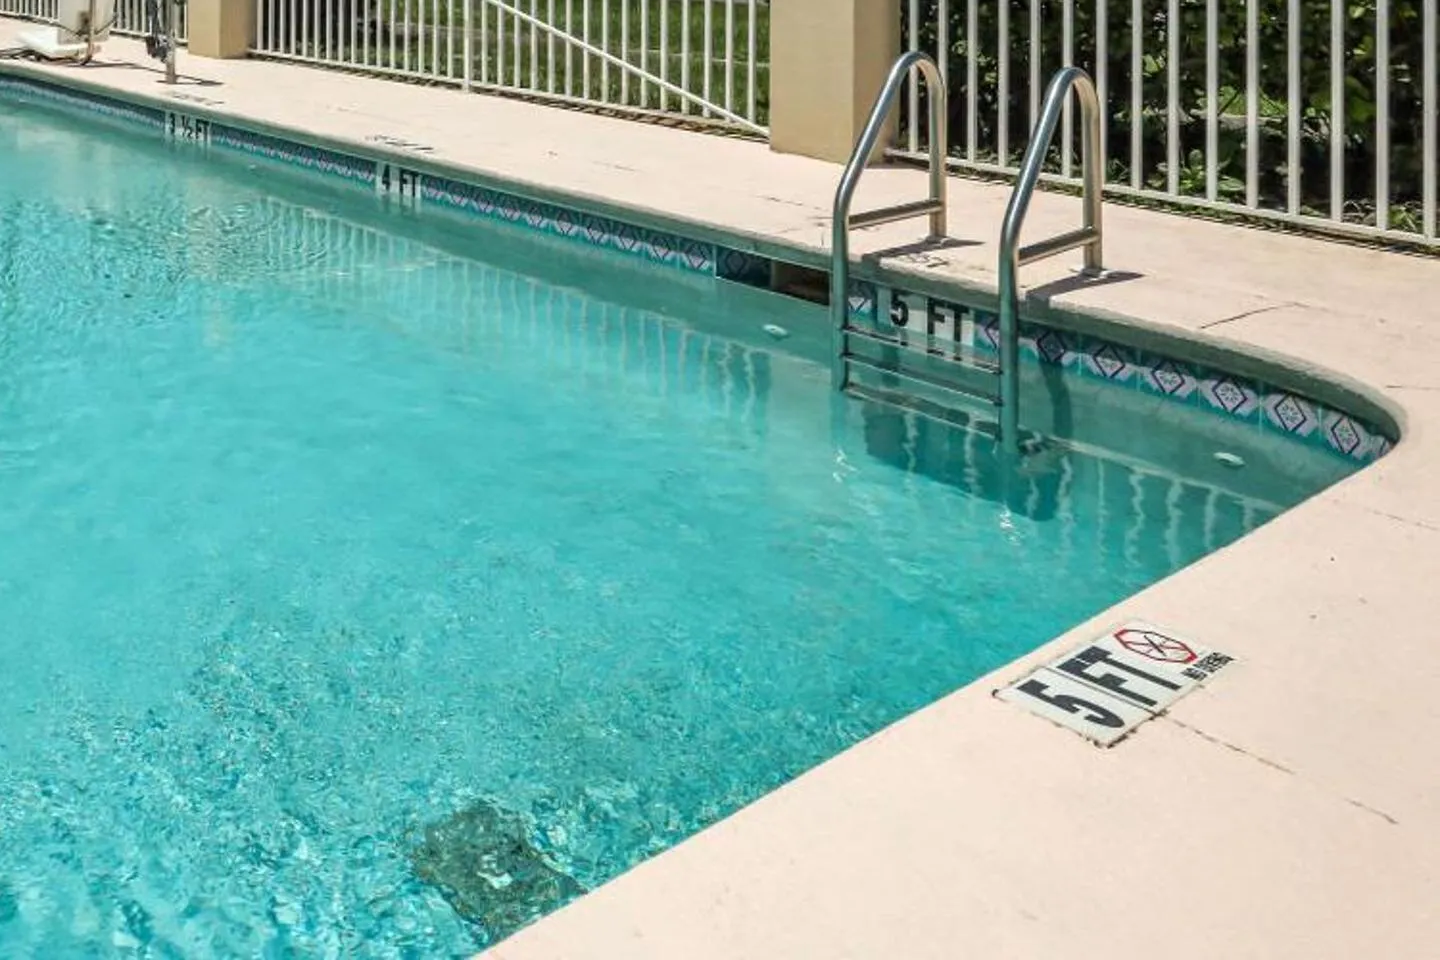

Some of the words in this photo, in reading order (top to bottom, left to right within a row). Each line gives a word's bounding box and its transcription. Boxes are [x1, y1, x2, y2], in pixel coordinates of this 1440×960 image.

[195, 119, 210, 141] FT
[382, 164, 391, 191] 4
[399, 168, 419, 197] FT
[891, 290, 909, 327] 5
[927, 297, 969, 342] FT
[1056, 646, 1182, 707] FT
[1017, 679, 1125, 728] 5
